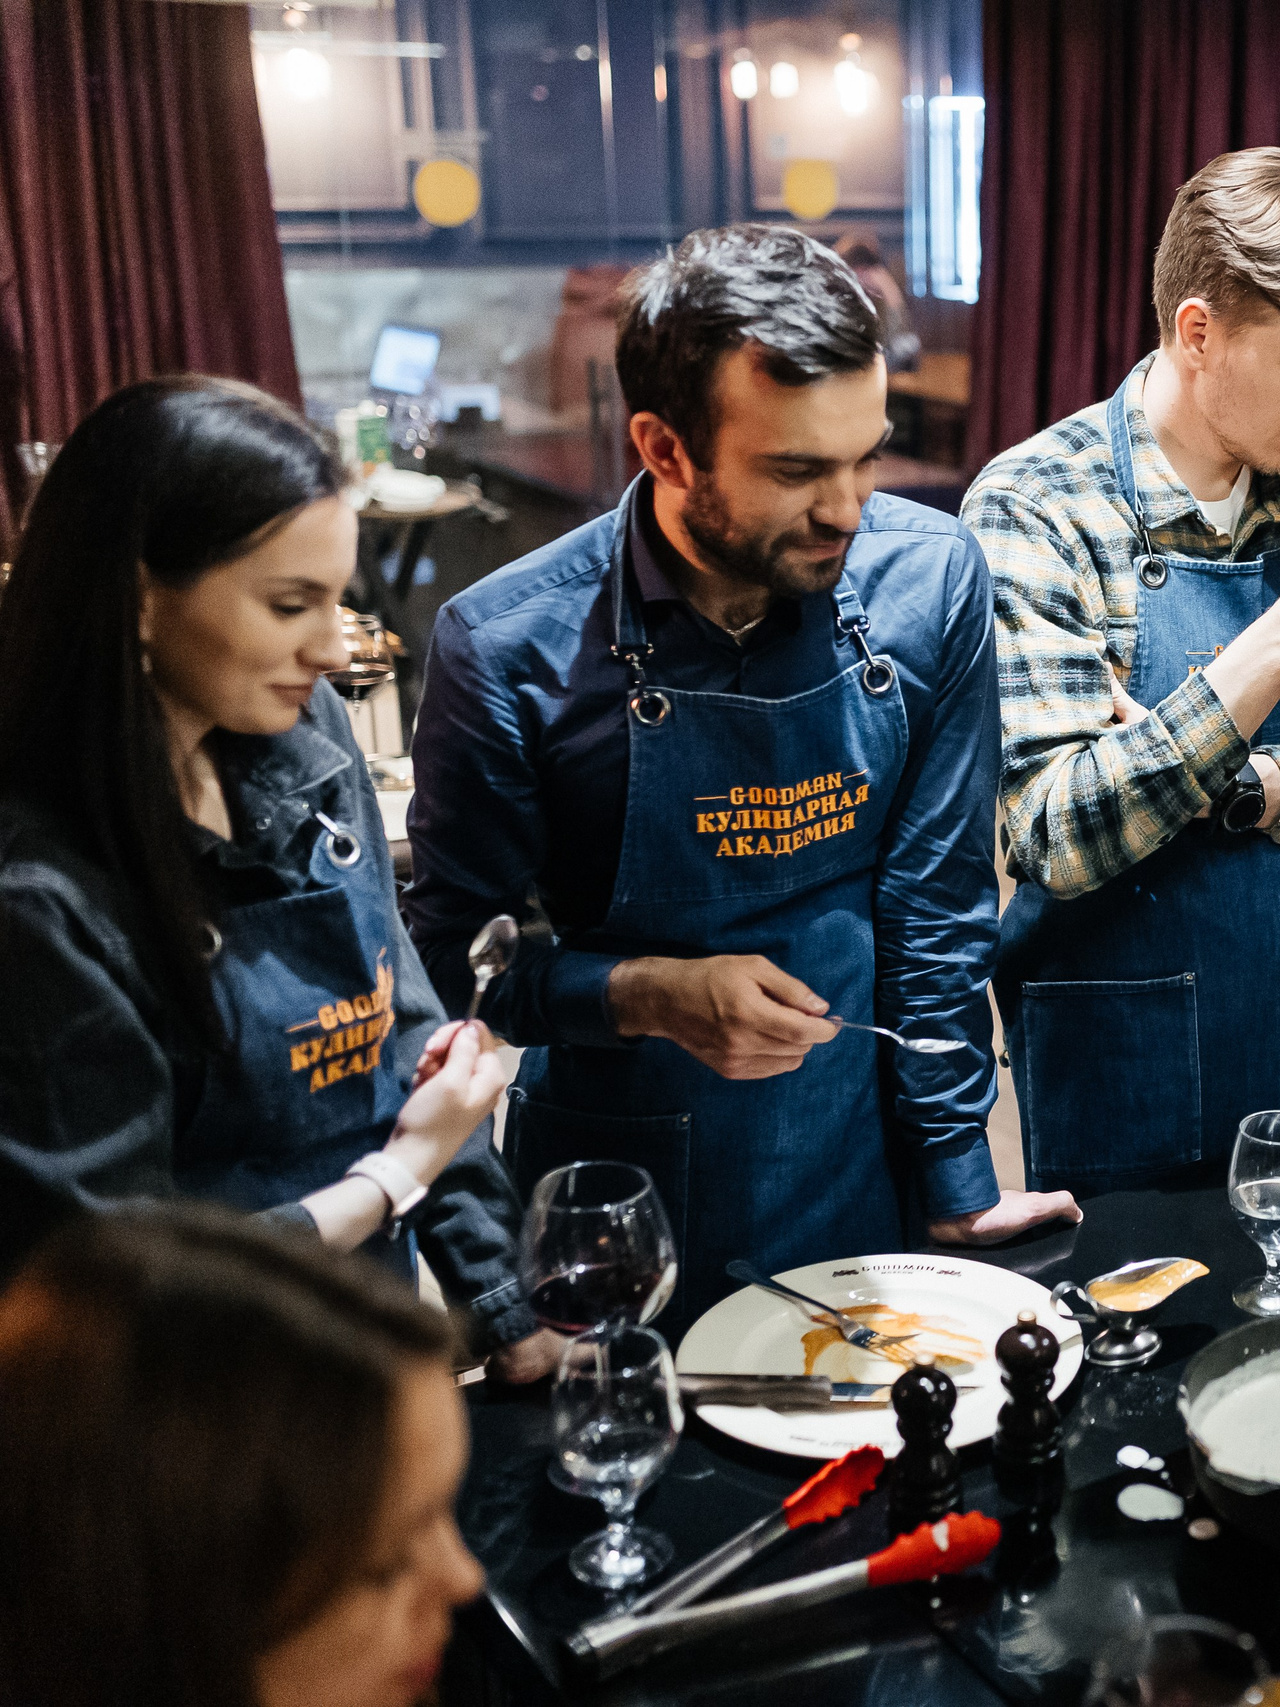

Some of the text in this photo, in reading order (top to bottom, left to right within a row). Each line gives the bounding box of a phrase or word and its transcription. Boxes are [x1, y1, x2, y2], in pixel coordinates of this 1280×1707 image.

[696, 784, 870, 834] КУЛИНАРНАЯ
[730, 772, 842, 806] GOODMAN
[716, 812, 856, 859] АКАДЕМИЯ
